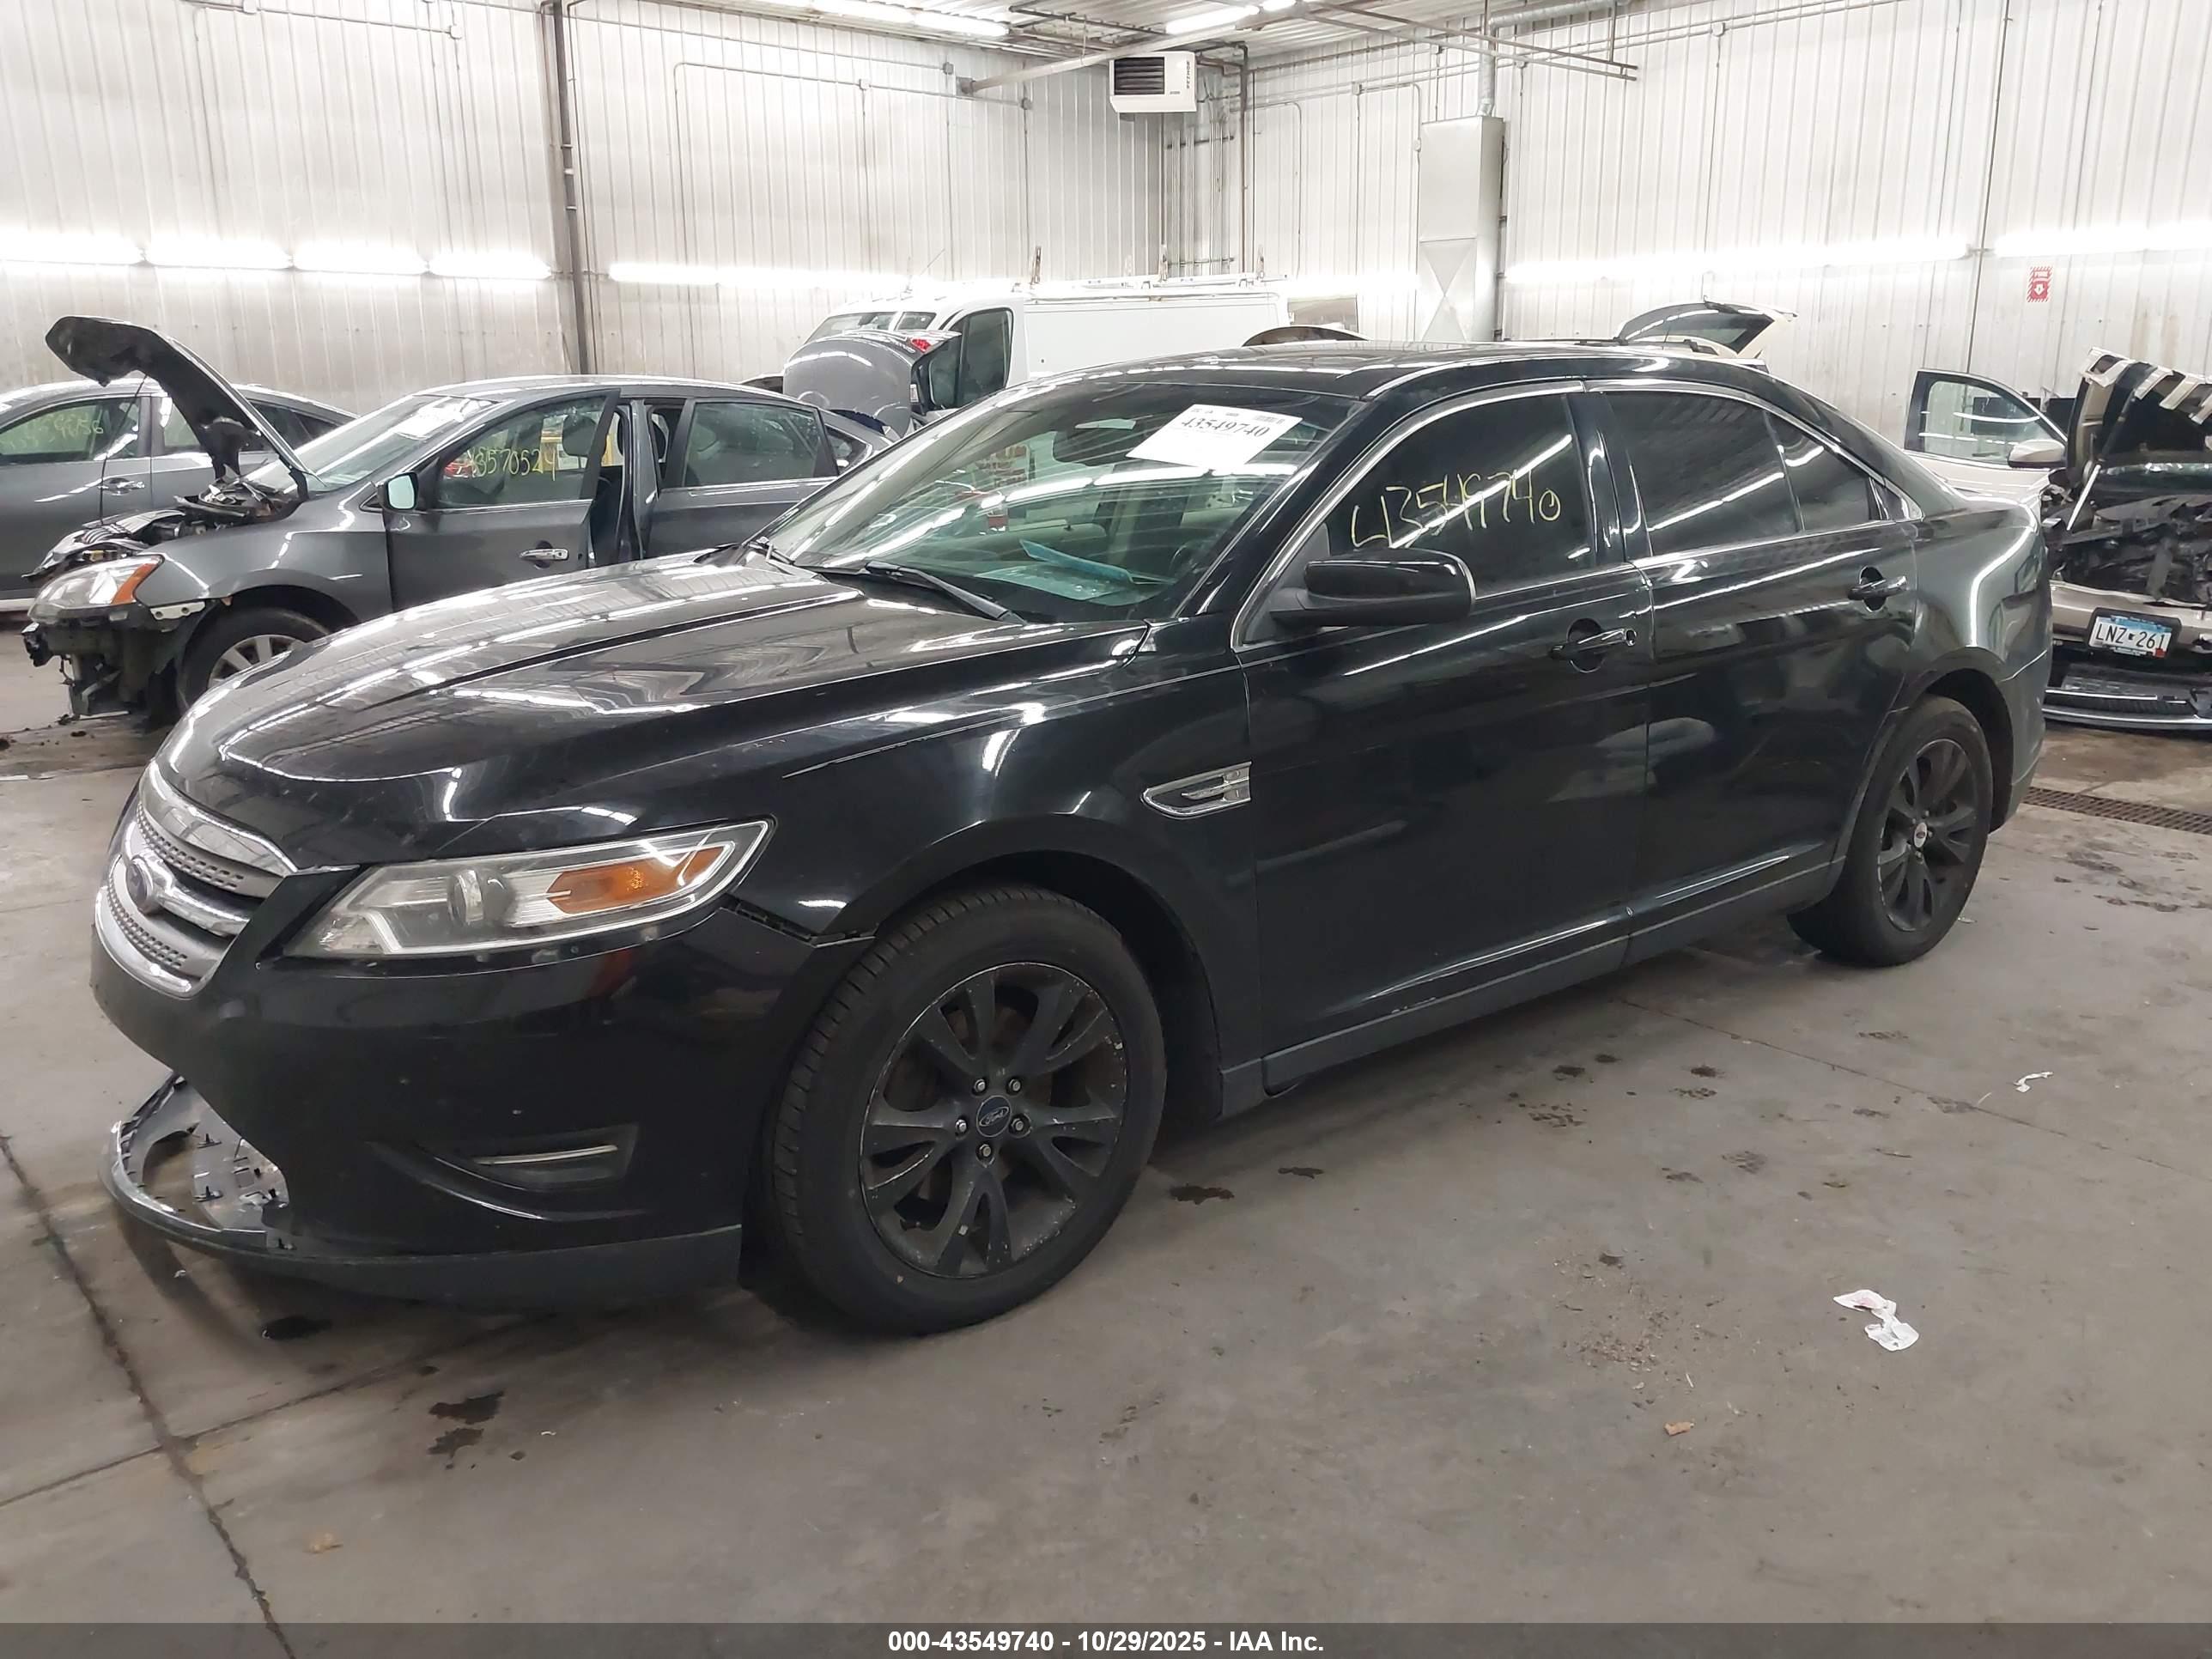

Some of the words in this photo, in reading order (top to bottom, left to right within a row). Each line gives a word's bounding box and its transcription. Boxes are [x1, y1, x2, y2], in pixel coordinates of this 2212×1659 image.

[1182, 417, 1271, 438] 43549740
[1351, 469, 1561, 549] 43549740
[2095, 623, 2128, 644] LNZ
[2136, 631, 2166, 650] 261
